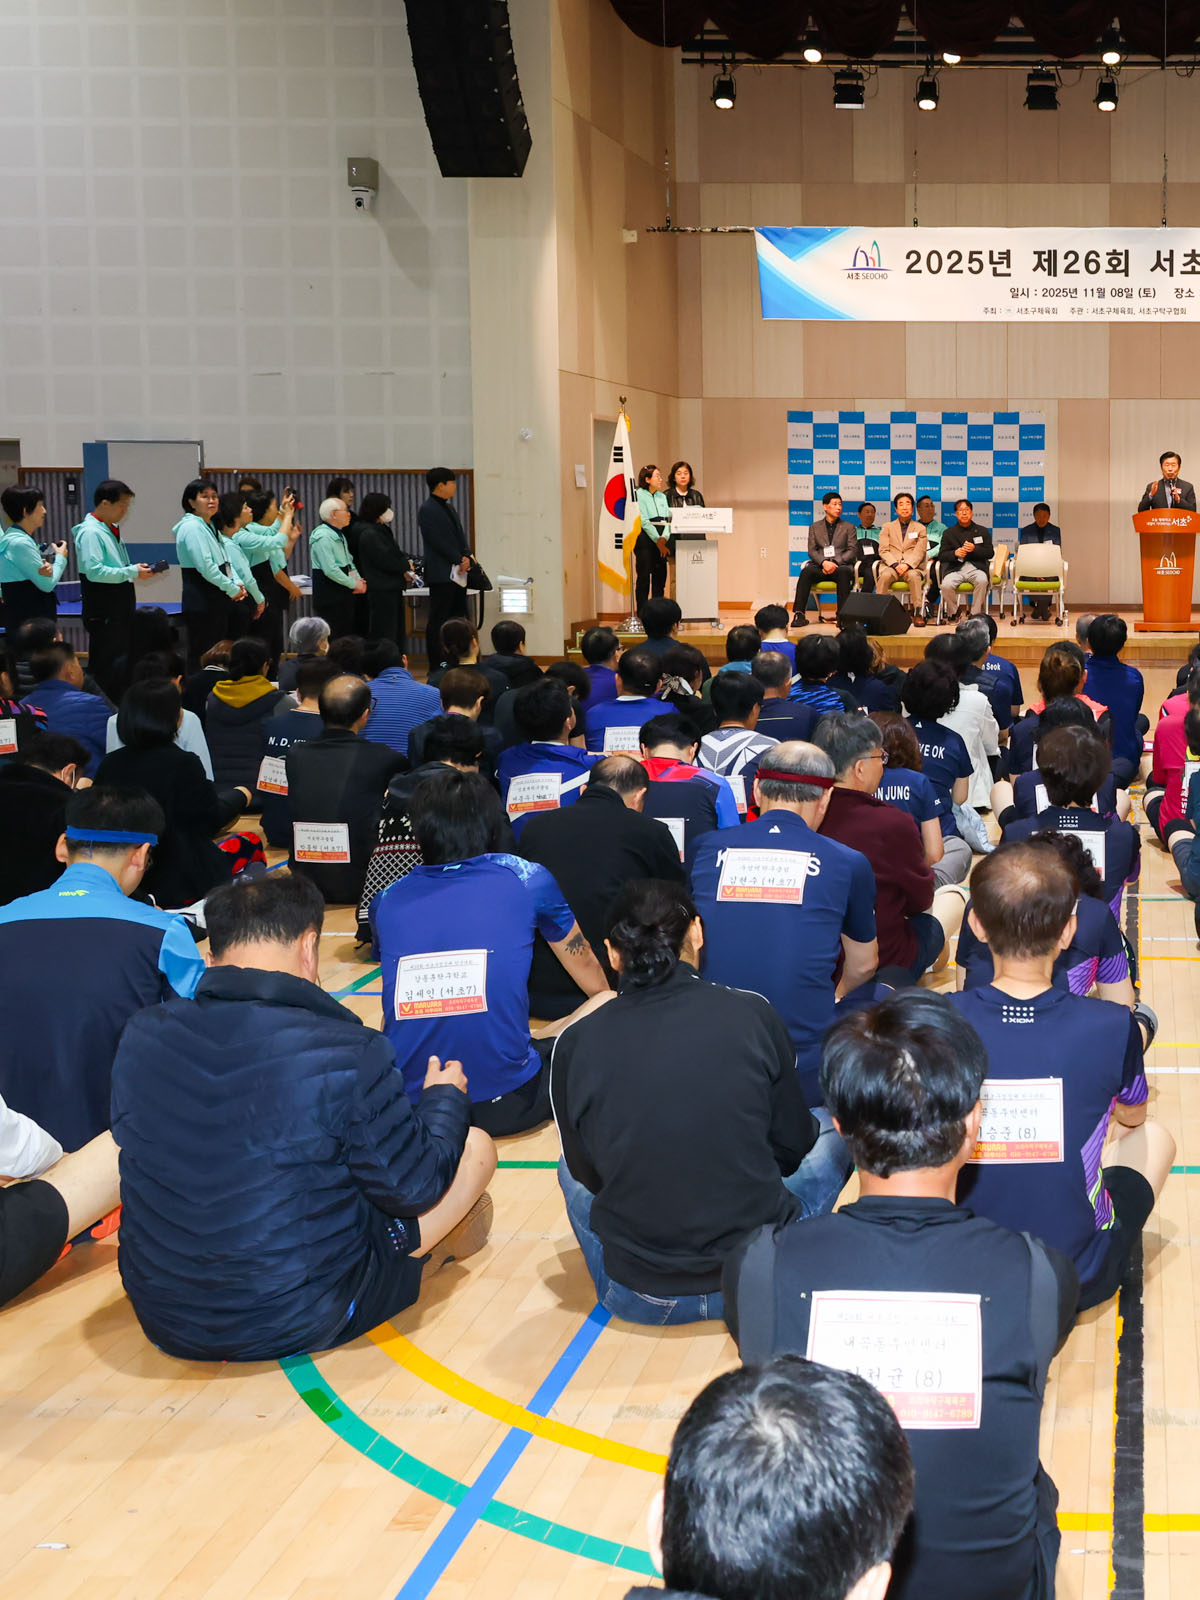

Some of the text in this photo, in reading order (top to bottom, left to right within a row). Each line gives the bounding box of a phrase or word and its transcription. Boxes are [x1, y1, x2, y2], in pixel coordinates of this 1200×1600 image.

[905, 249, 1012, 277] 2025년
[1032, 249, 1130, 277] 제26회
[846, 272, 888, 280] 서초 SEOCHO
[1009, 287, 1031, 299] 일시
[1041, 287, 1079, 299] 2025년
[1083, 287, 1105, 299] 11월
[1110, 287, 1134, 299] 08일
[1138, 287, 1157, 299] (토)
[1173, 287, 1195, 299] 장소
[931, 745, 945, 759] OK
[885, 786, 910, 801] JUNG
[1018, 1127, 1037, 1140] (8)
[915, 1369, 943, 1389] (8)
